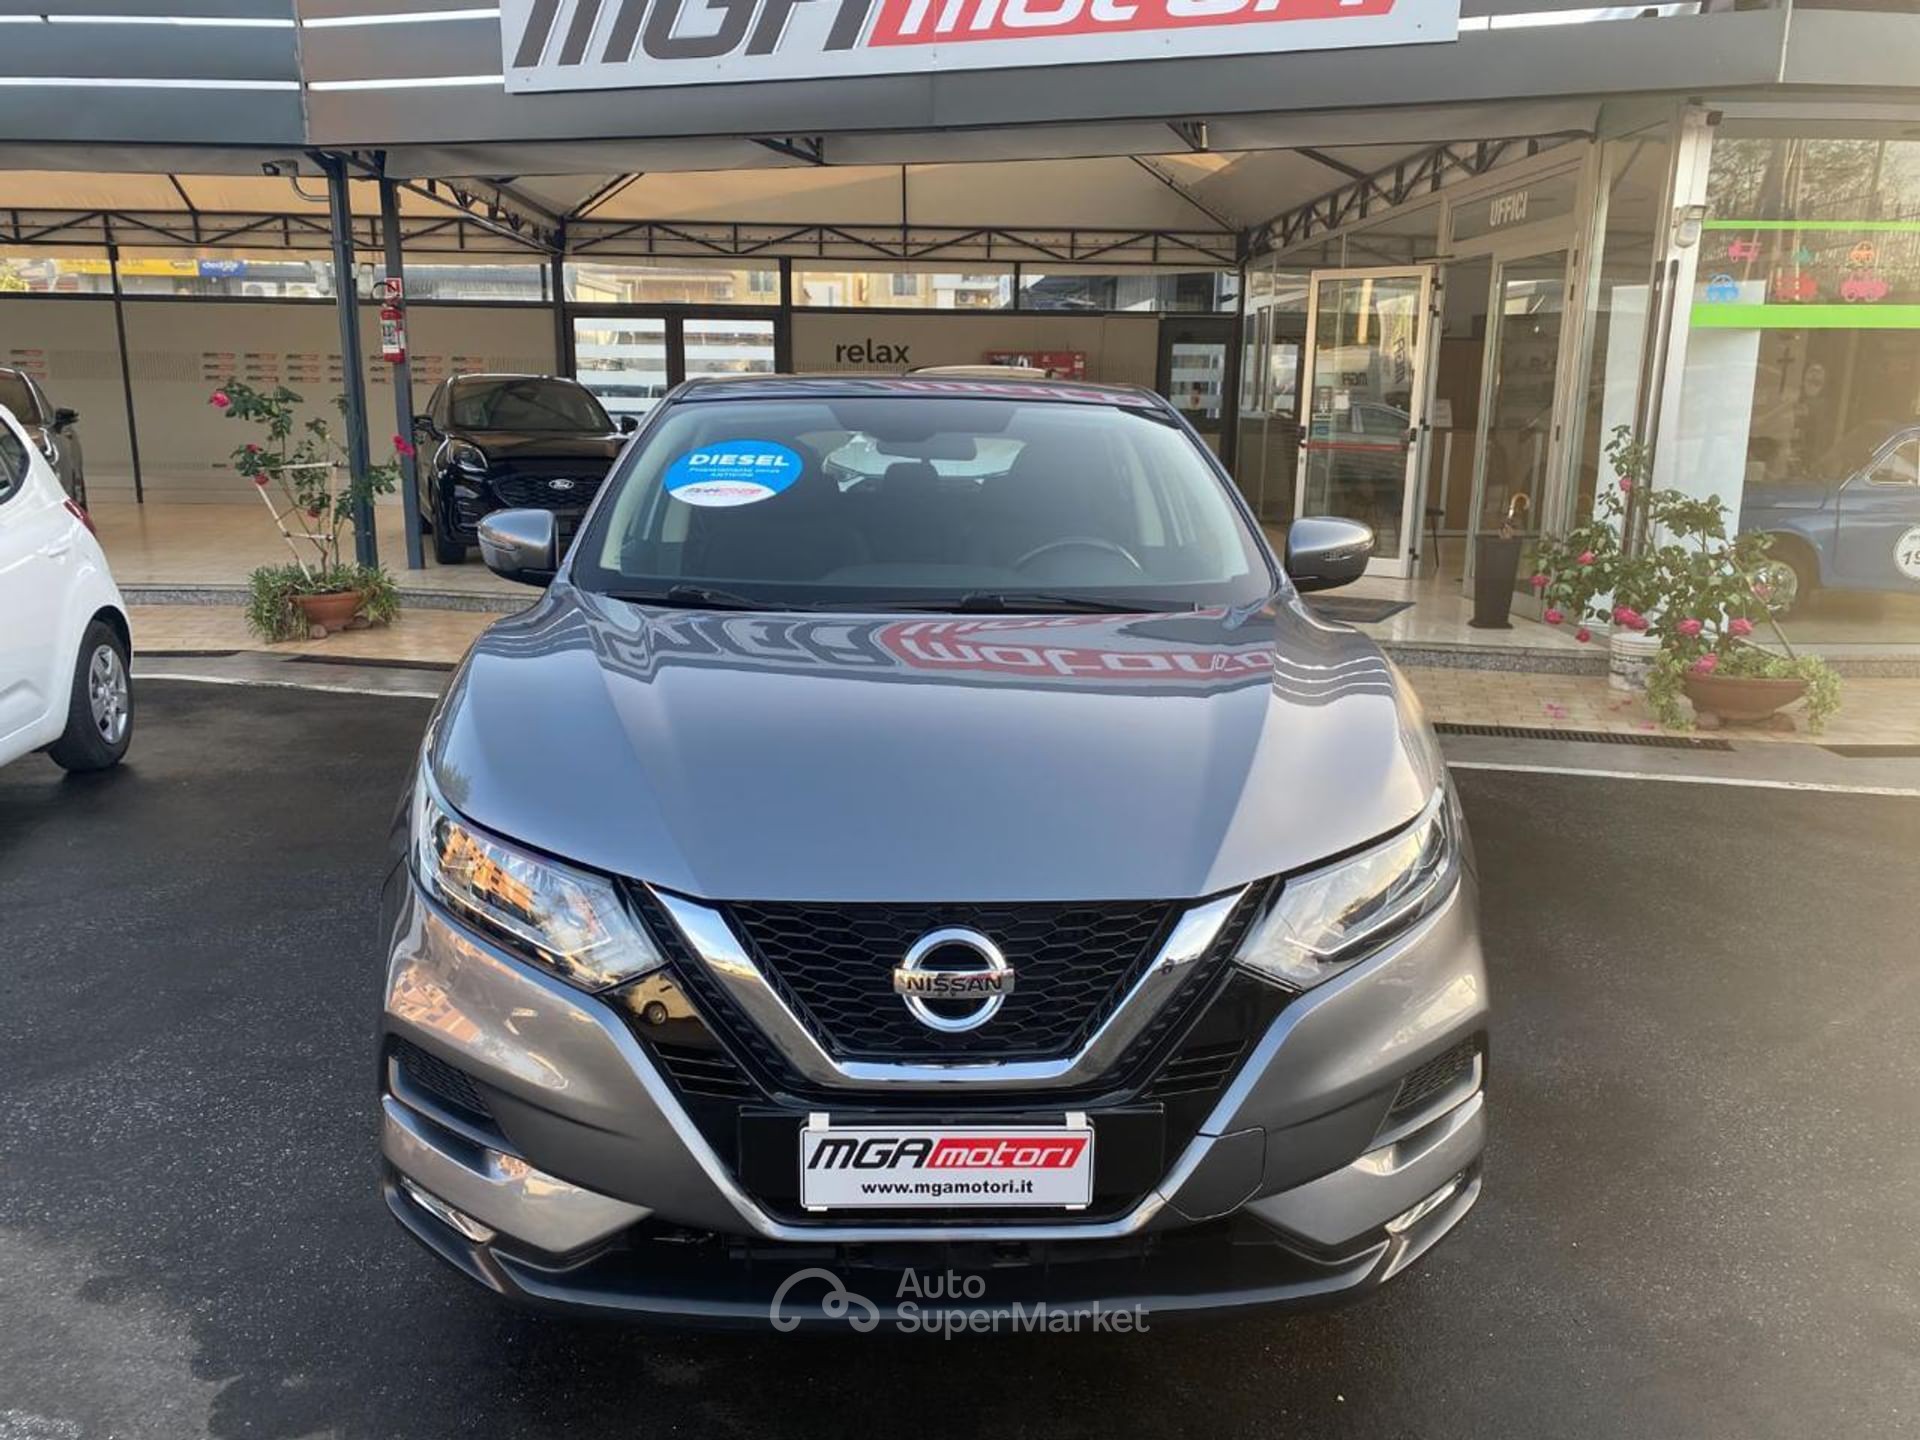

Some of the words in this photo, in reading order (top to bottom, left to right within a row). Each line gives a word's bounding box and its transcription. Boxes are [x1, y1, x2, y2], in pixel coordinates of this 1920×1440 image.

[1490, 191, 1528, 226] UFFICI
[836, 338, 911, 364] relax
[688, 453, 789, 467] DIESEL
[906, 975, 1002, 992] NISSAN
[807, 1138, 934, 1169] MGA
[934, 1141, 1074, 1167] motori
[861, 1180, 1033, 1197] www.mgamotori.it
